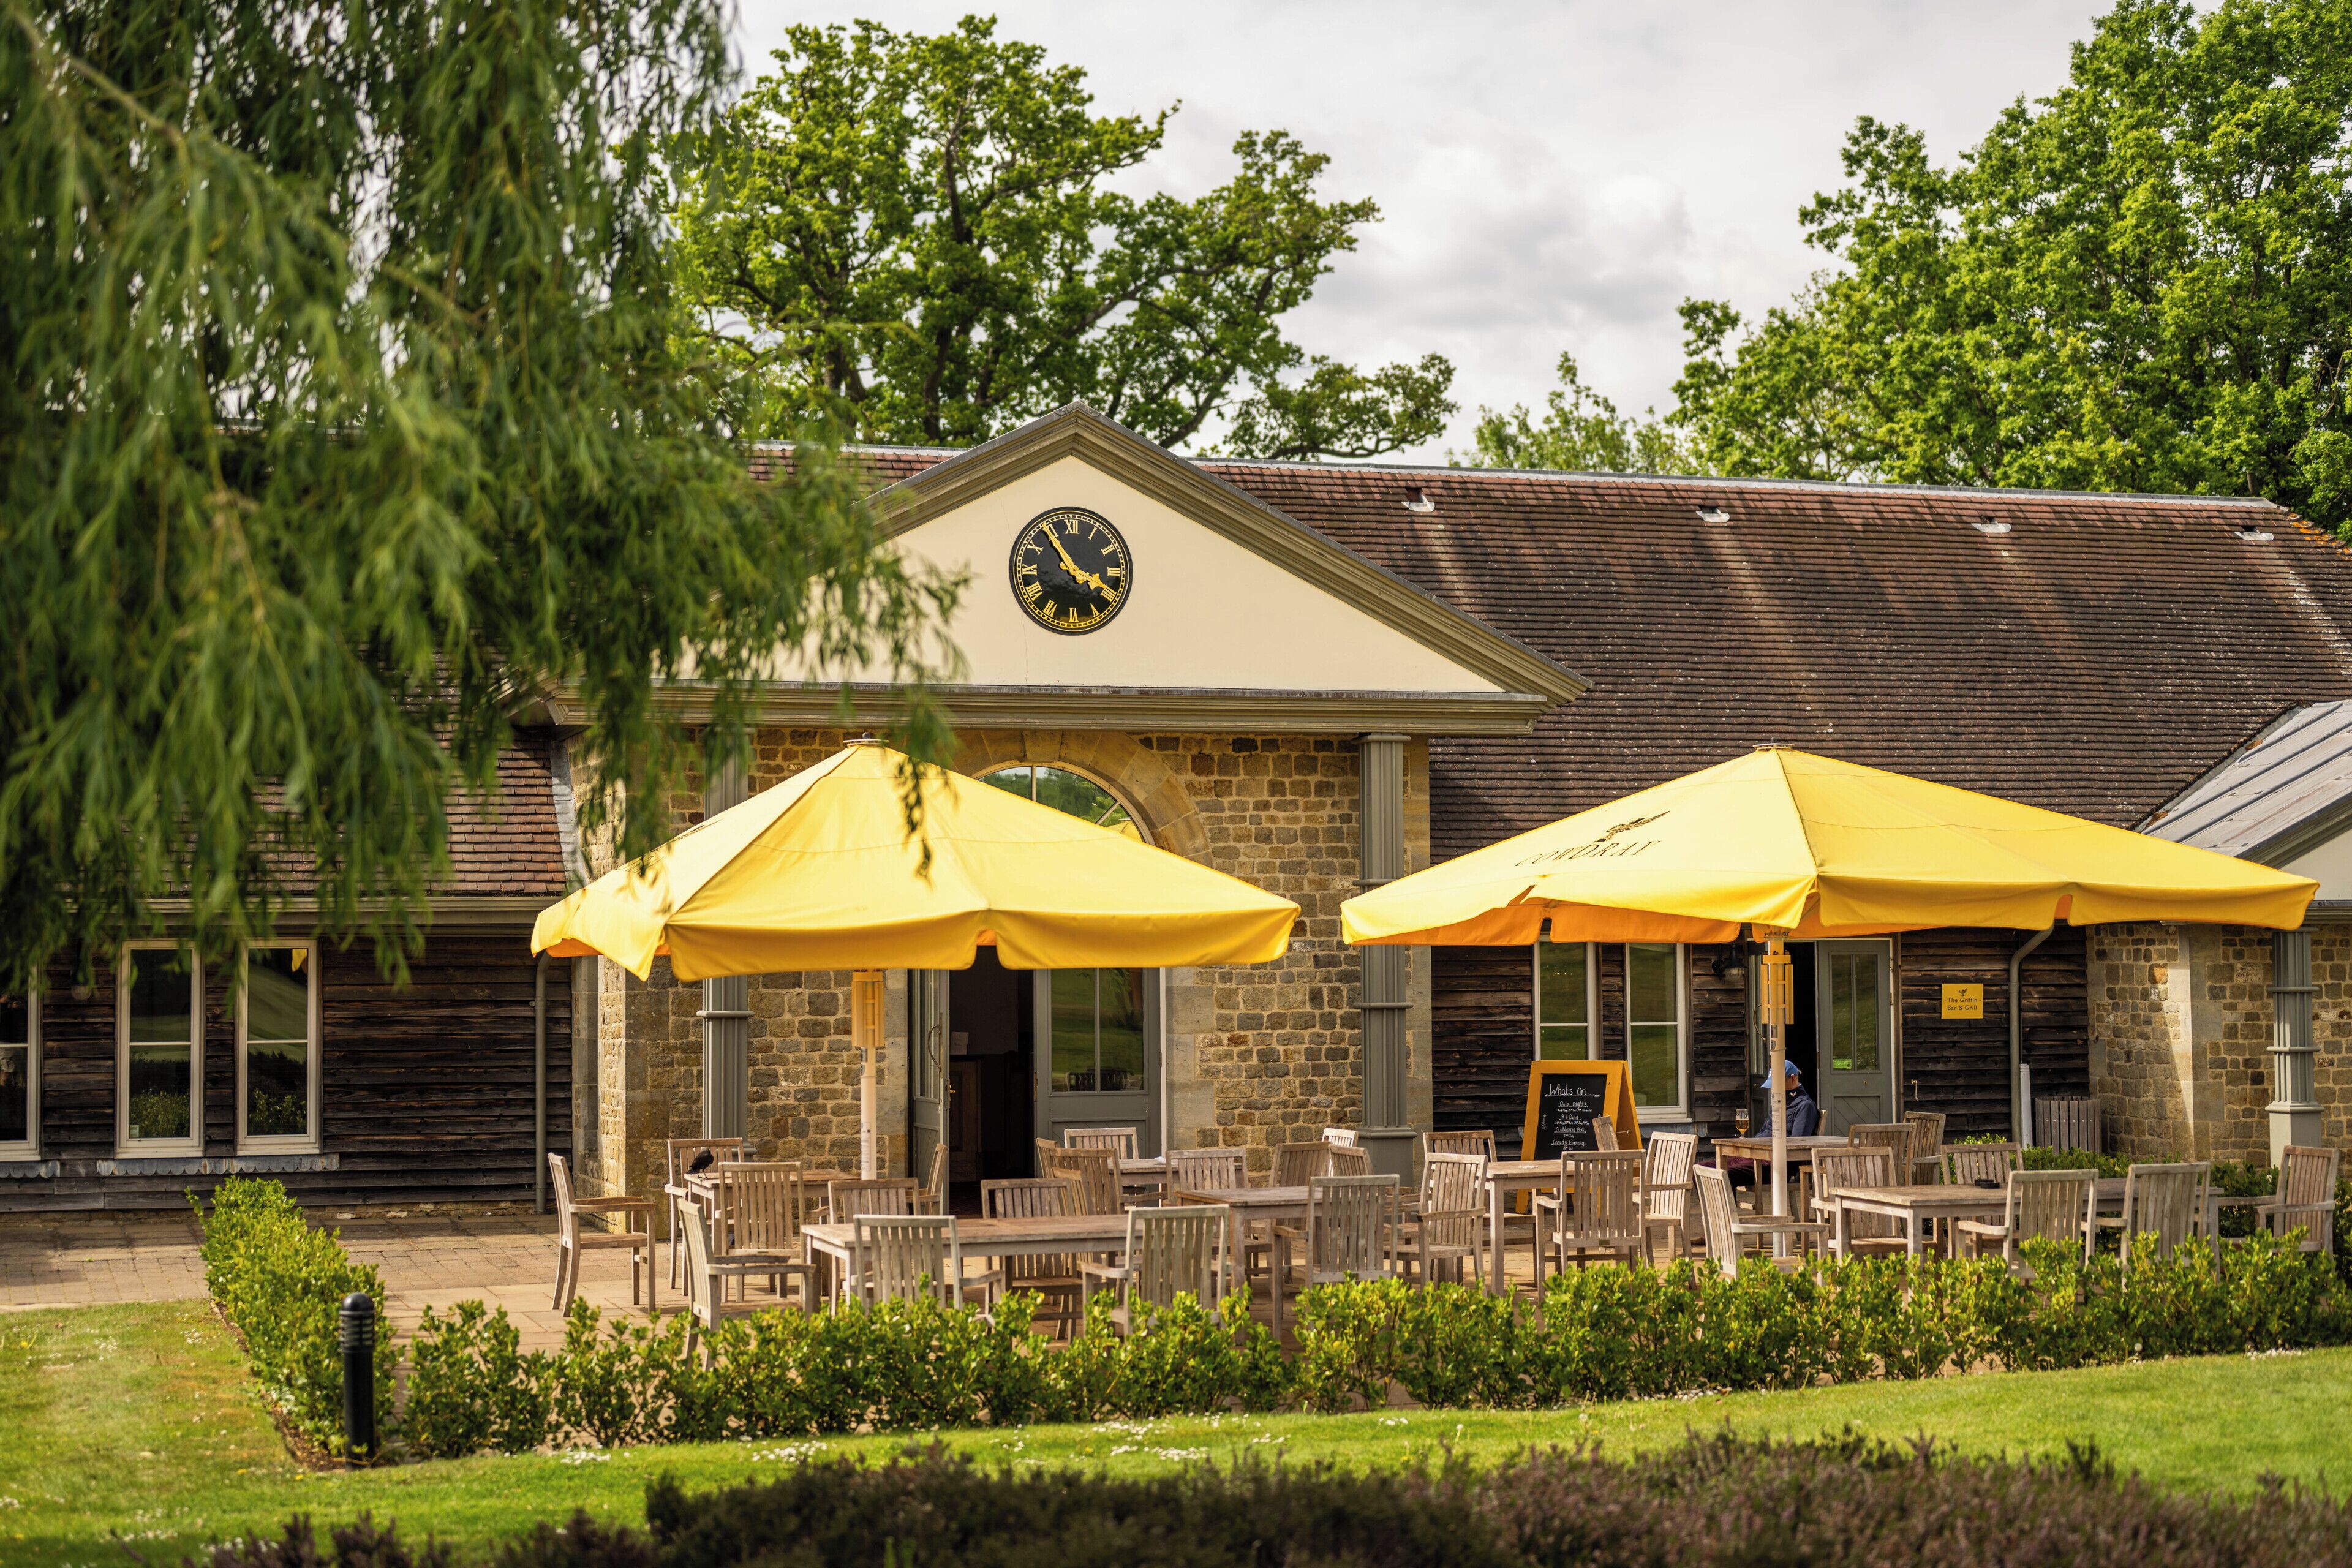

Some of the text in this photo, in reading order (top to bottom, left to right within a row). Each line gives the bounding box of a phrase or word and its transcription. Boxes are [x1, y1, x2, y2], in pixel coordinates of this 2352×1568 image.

[1064, 519, 1079, 534] XII
[1088, 527, 1098, 540] I
[1027, 540, 1044, 556] X
[1101, 543, 1116, 556] II
[1022, 563, 1038, 576] IX
[1107, 567, 1120, 578] III
[1025, 581, 1044, 601] VIII
[1042, 599, 1058, 618] VII
[1068, 607, 1079, 622] VI
[1090, 603, 1100, 617] V
[1515, 840, 1661, 867] COWDRAY
[1550, 1084, 1573, 1095] Whats
[1577, 1087, 1586, 1096] On
[1572, 1101, 1587, 1110] nights
